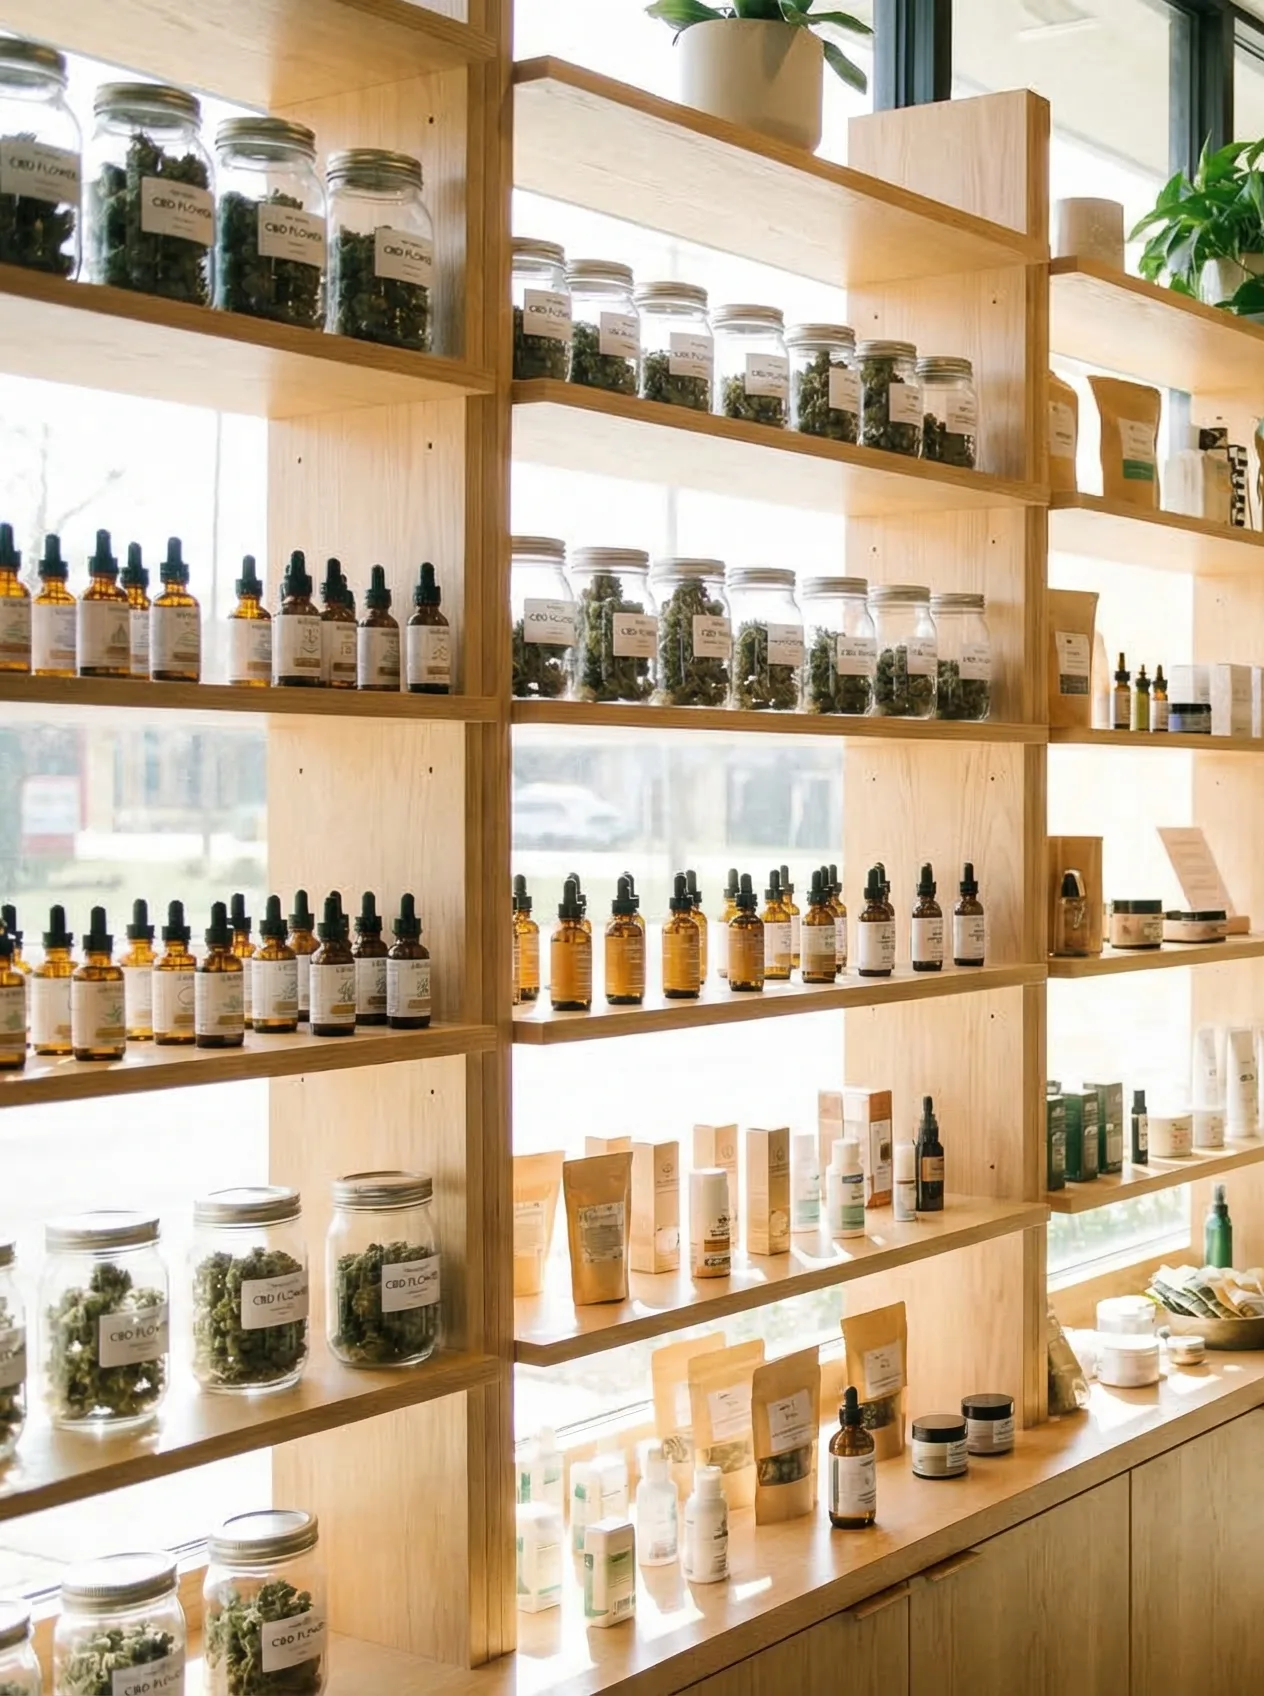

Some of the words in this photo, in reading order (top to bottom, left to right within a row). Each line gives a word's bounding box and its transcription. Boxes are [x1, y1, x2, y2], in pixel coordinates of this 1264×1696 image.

[152, 196, 176, 210] CBD
[265, 222, 288, 235] CBD
[289, 225, 322, 241] FLOWER
[385, 1278, 406, 1290] CBD
[252, 1294, 275, 1306] CBD
[110, 1330, 133, 1342] CBD
[271, 1635, 295, 1648] CBD
